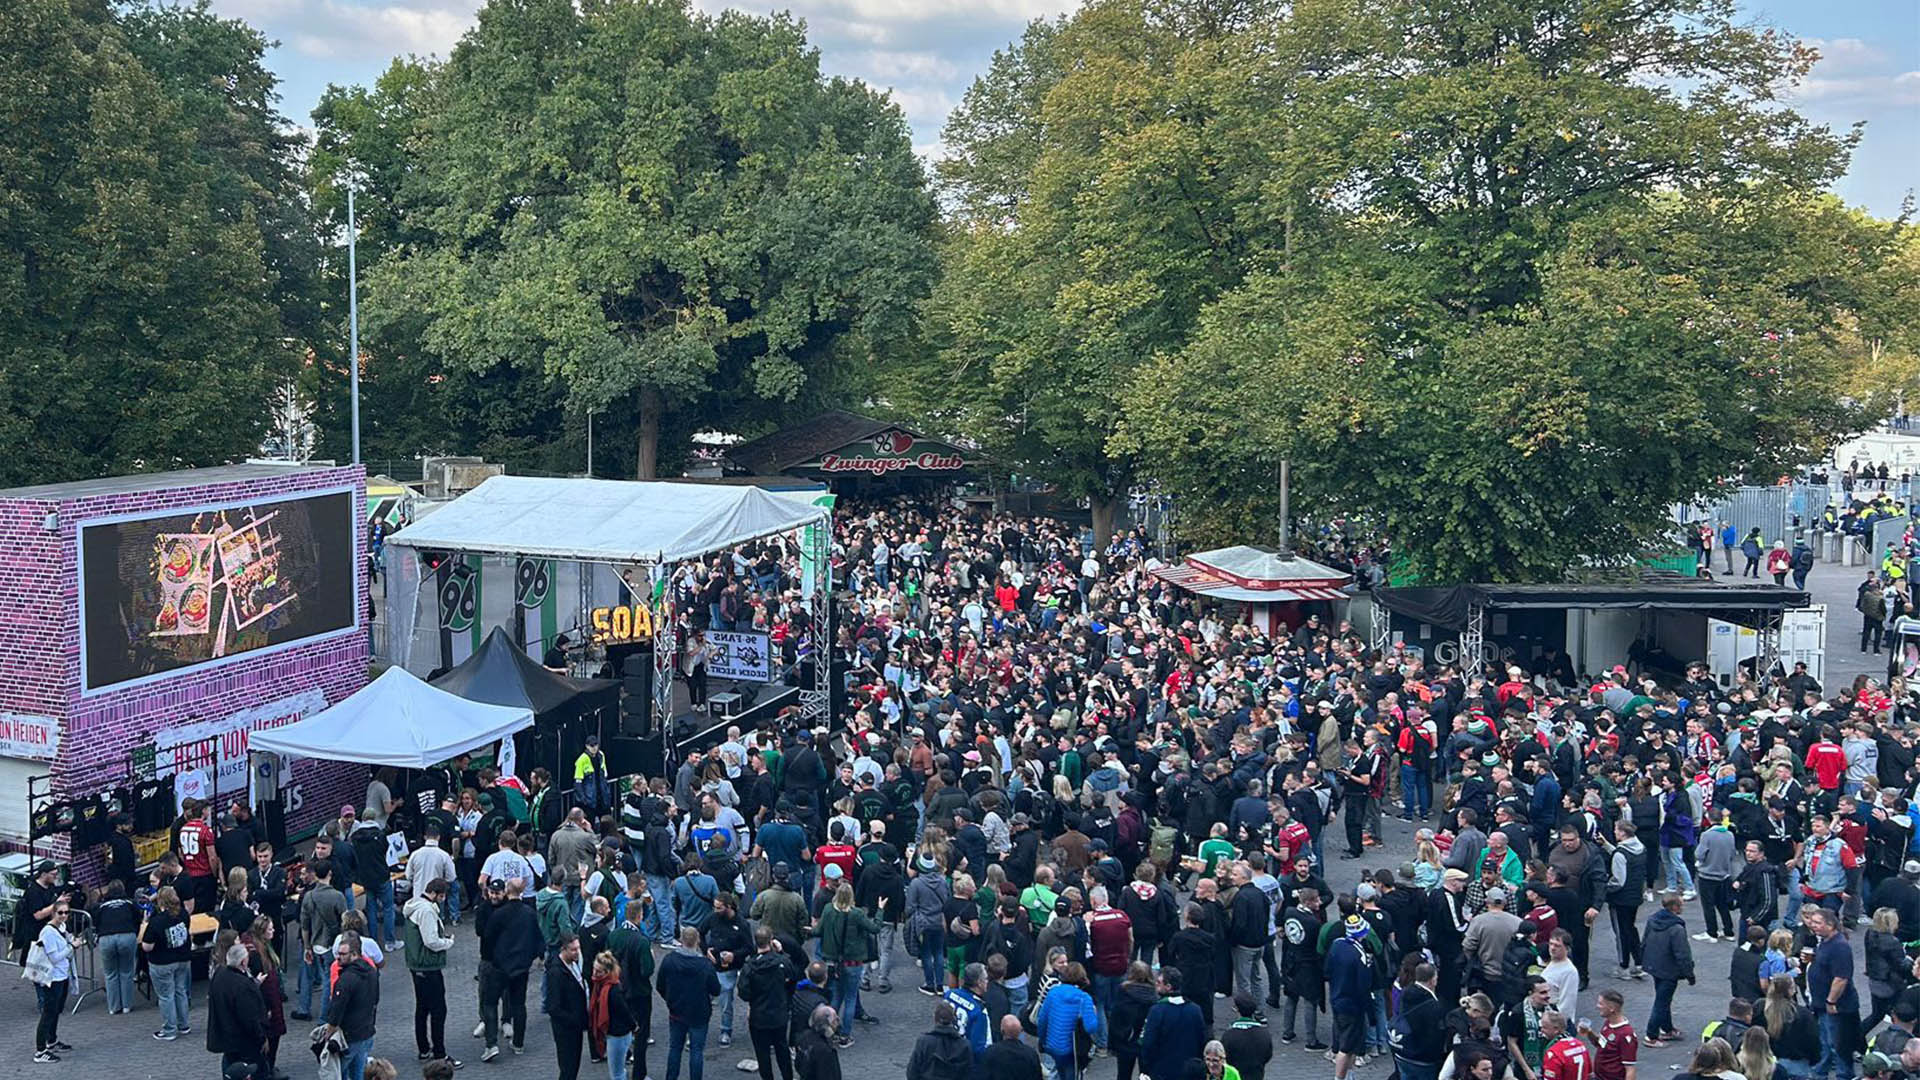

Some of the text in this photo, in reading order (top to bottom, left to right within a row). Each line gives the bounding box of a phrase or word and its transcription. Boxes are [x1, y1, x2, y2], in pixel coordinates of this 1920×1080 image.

[876, 433, 892, 453] 96
[820, 453, 963, 476] Zwinger Club
[519, 559, 548, 603] 96
[441, 573, 475, 627] 96
[592, 603, 660, 640] SOA
[13, 720, 47, 745] HEIDEN
[174, 727, 249, 776] HEIN VON
[180, 831, 199, 855] 96
